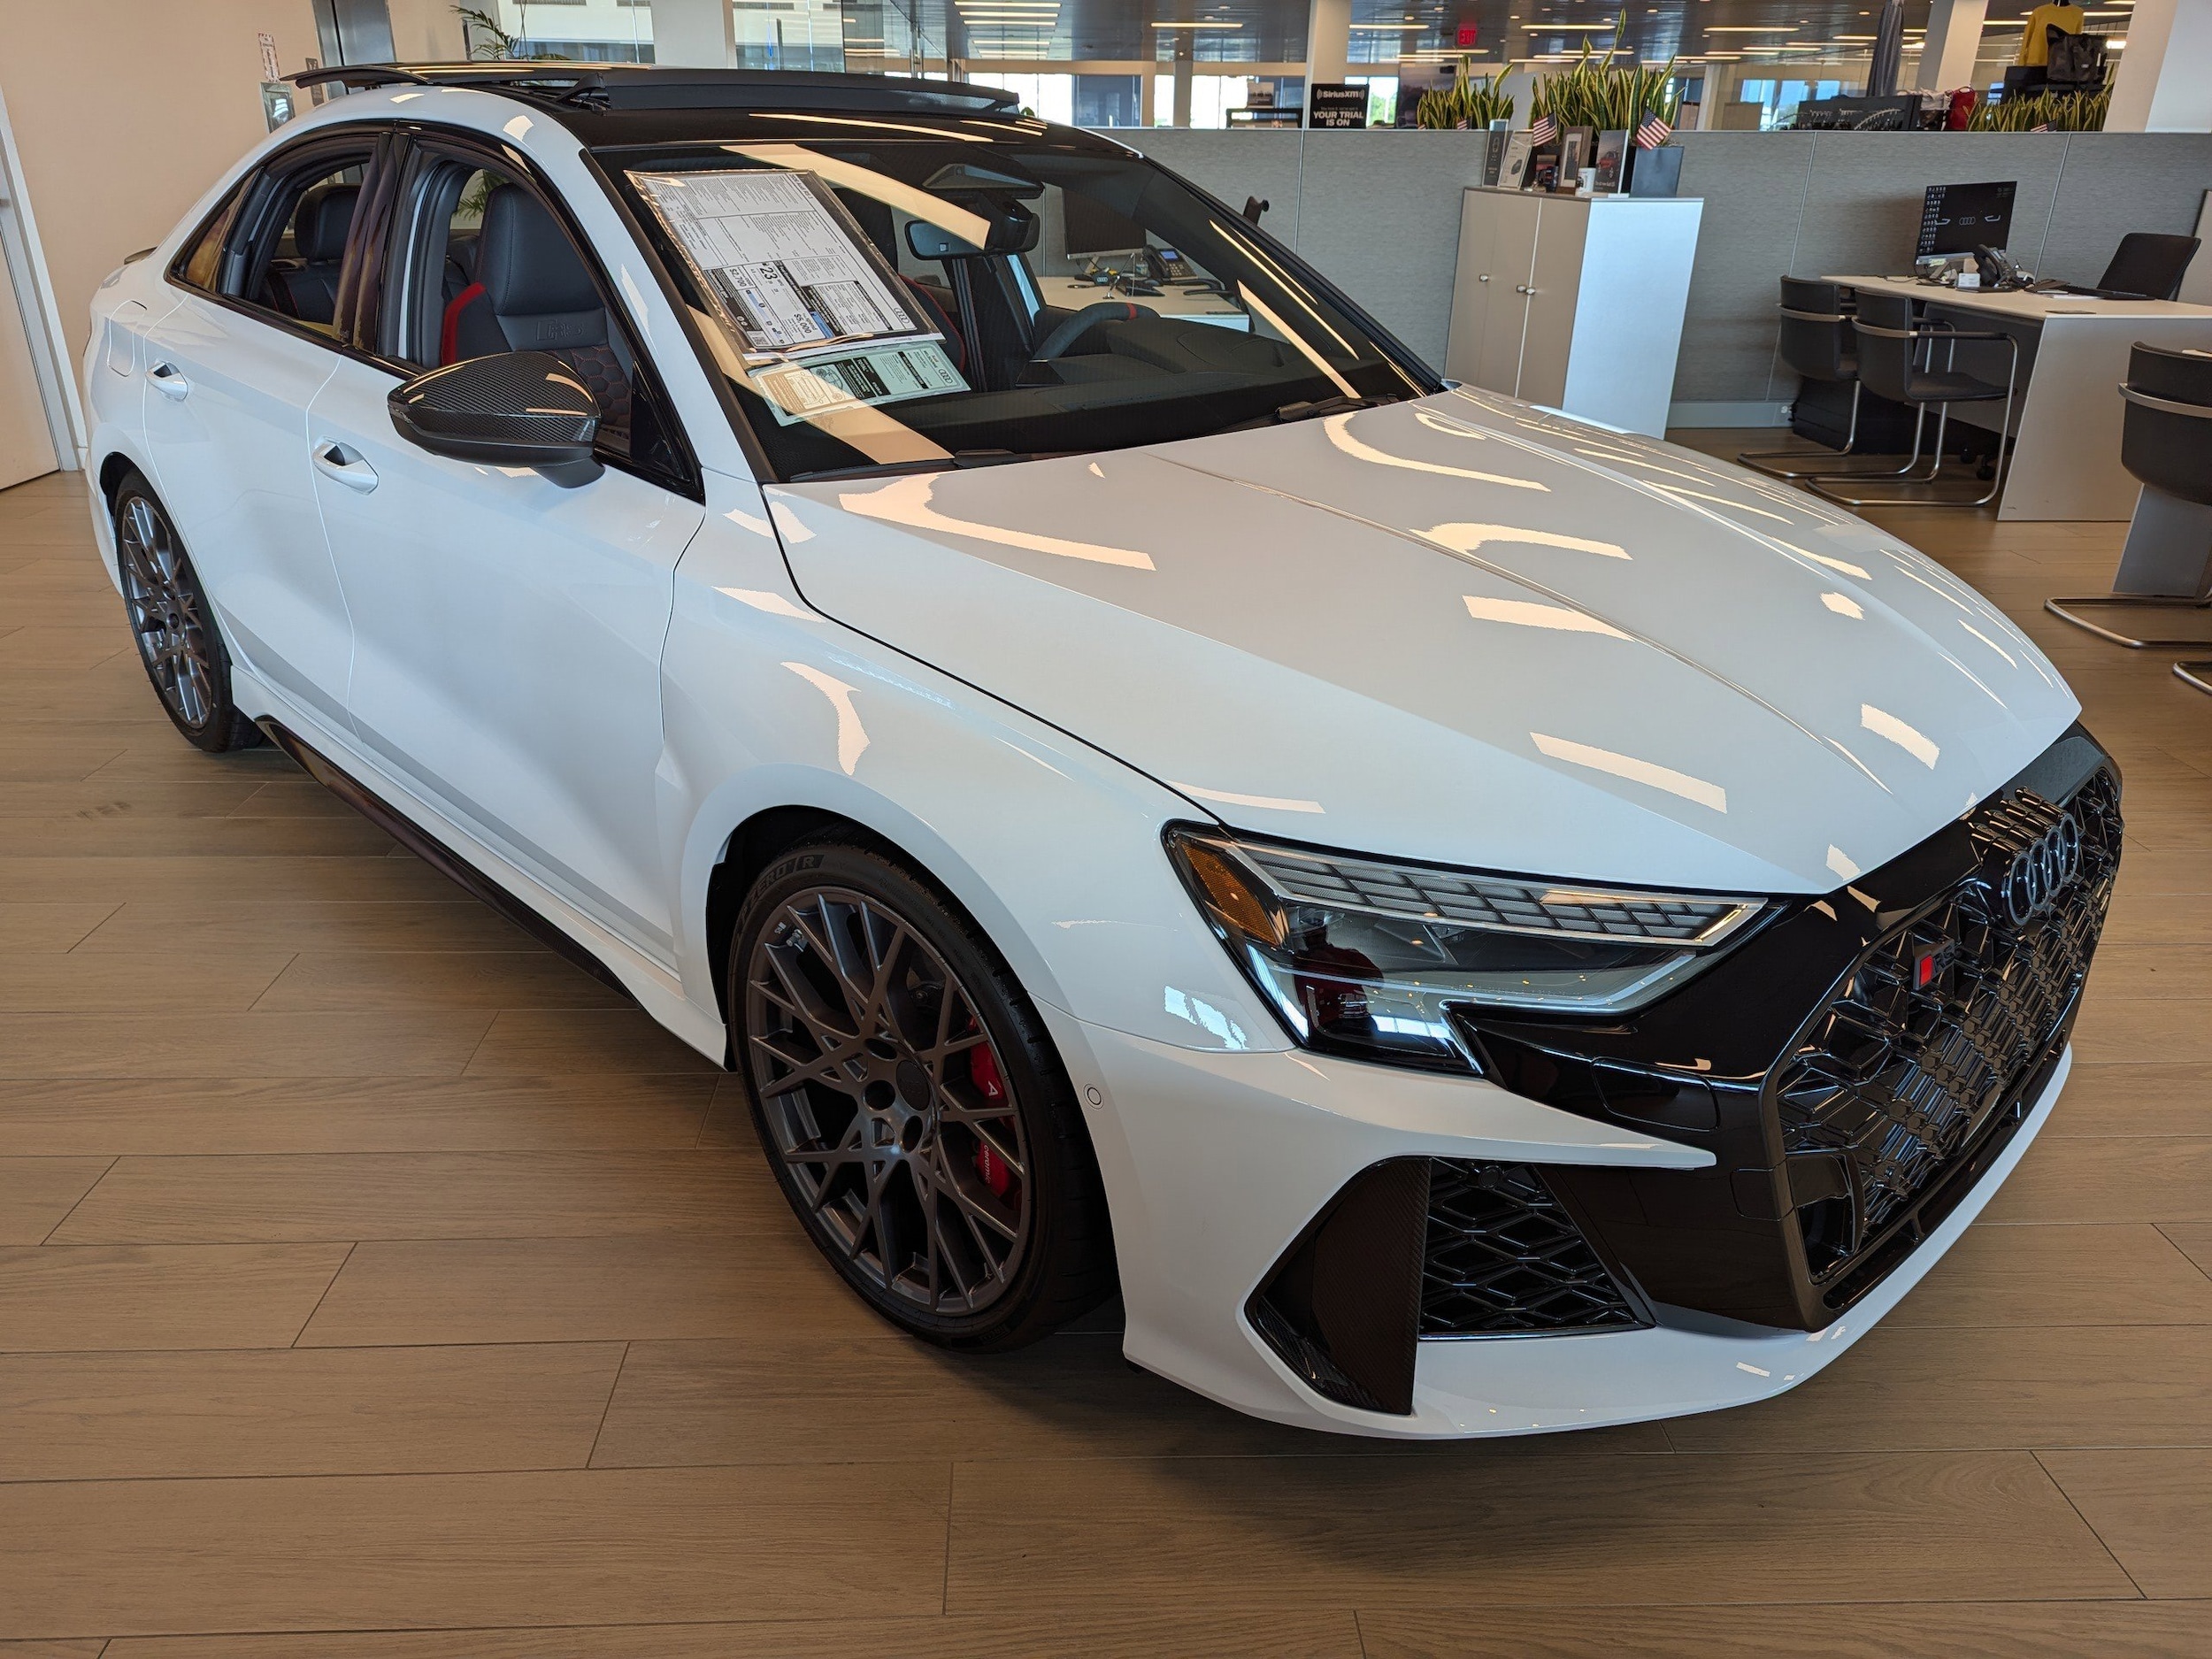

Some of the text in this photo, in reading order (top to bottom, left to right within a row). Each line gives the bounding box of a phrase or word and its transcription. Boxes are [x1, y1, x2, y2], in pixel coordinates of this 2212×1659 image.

[727, 268, 749, 287] $2,700
[758, 266, 780, 279] 23
[790, 313, 813, 333] $5,000
[802, 856, 815, 869] R
[983, 1145, 992, 1184] ceramic
